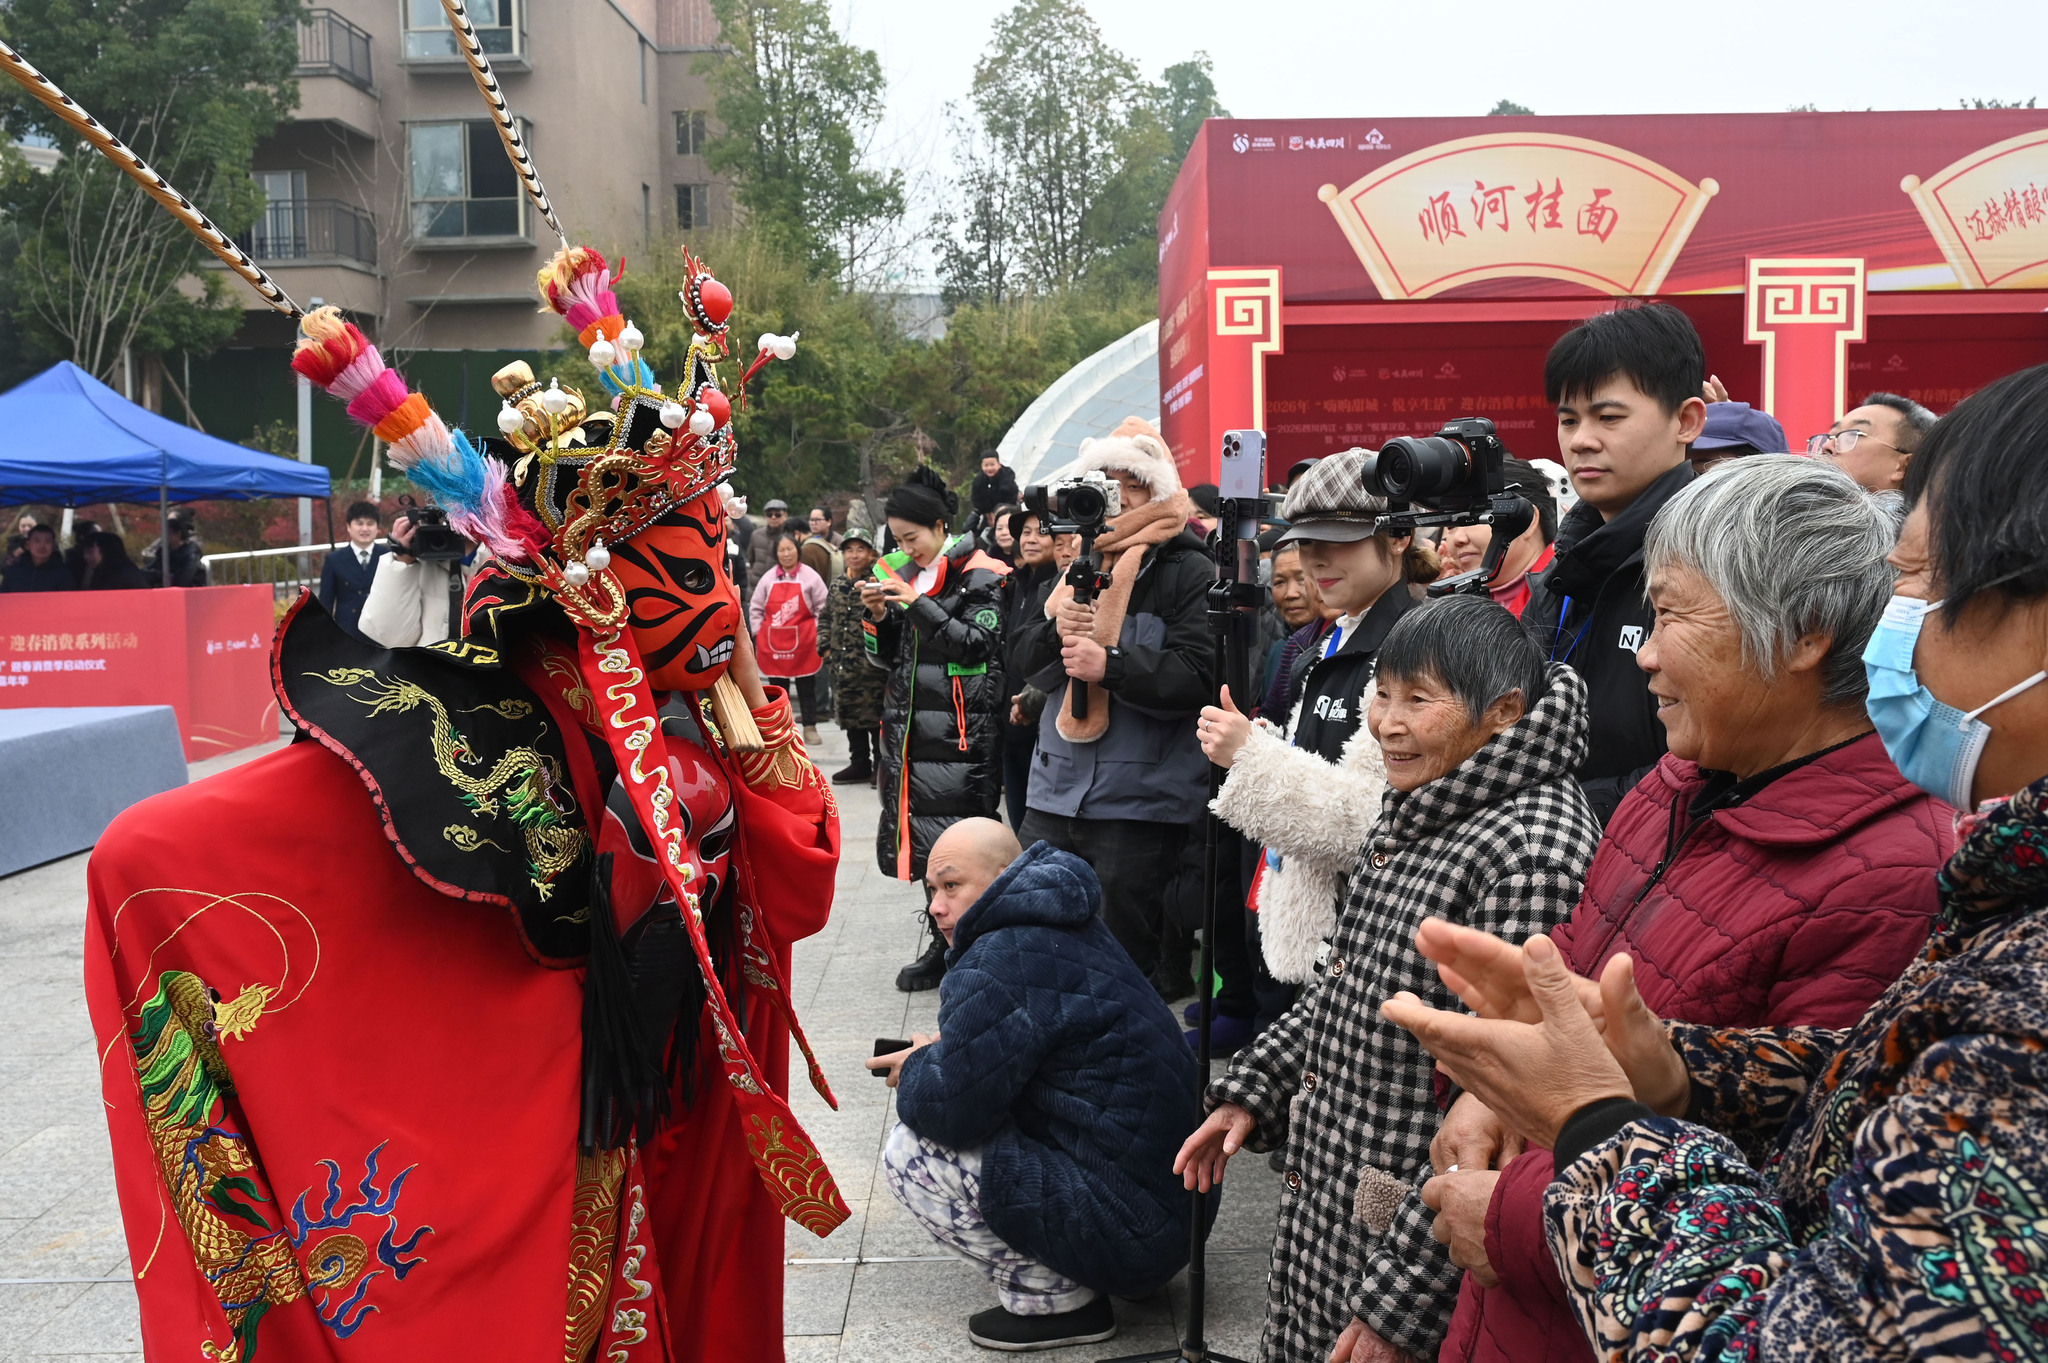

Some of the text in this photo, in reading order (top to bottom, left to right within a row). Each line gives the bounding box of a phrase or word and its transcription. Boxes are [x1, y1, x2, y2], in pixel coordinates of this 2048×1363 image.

[1419, 177, 1619, 246] 顺河挂面
[9, 632, 138, 652] 迎春消费系列活动
